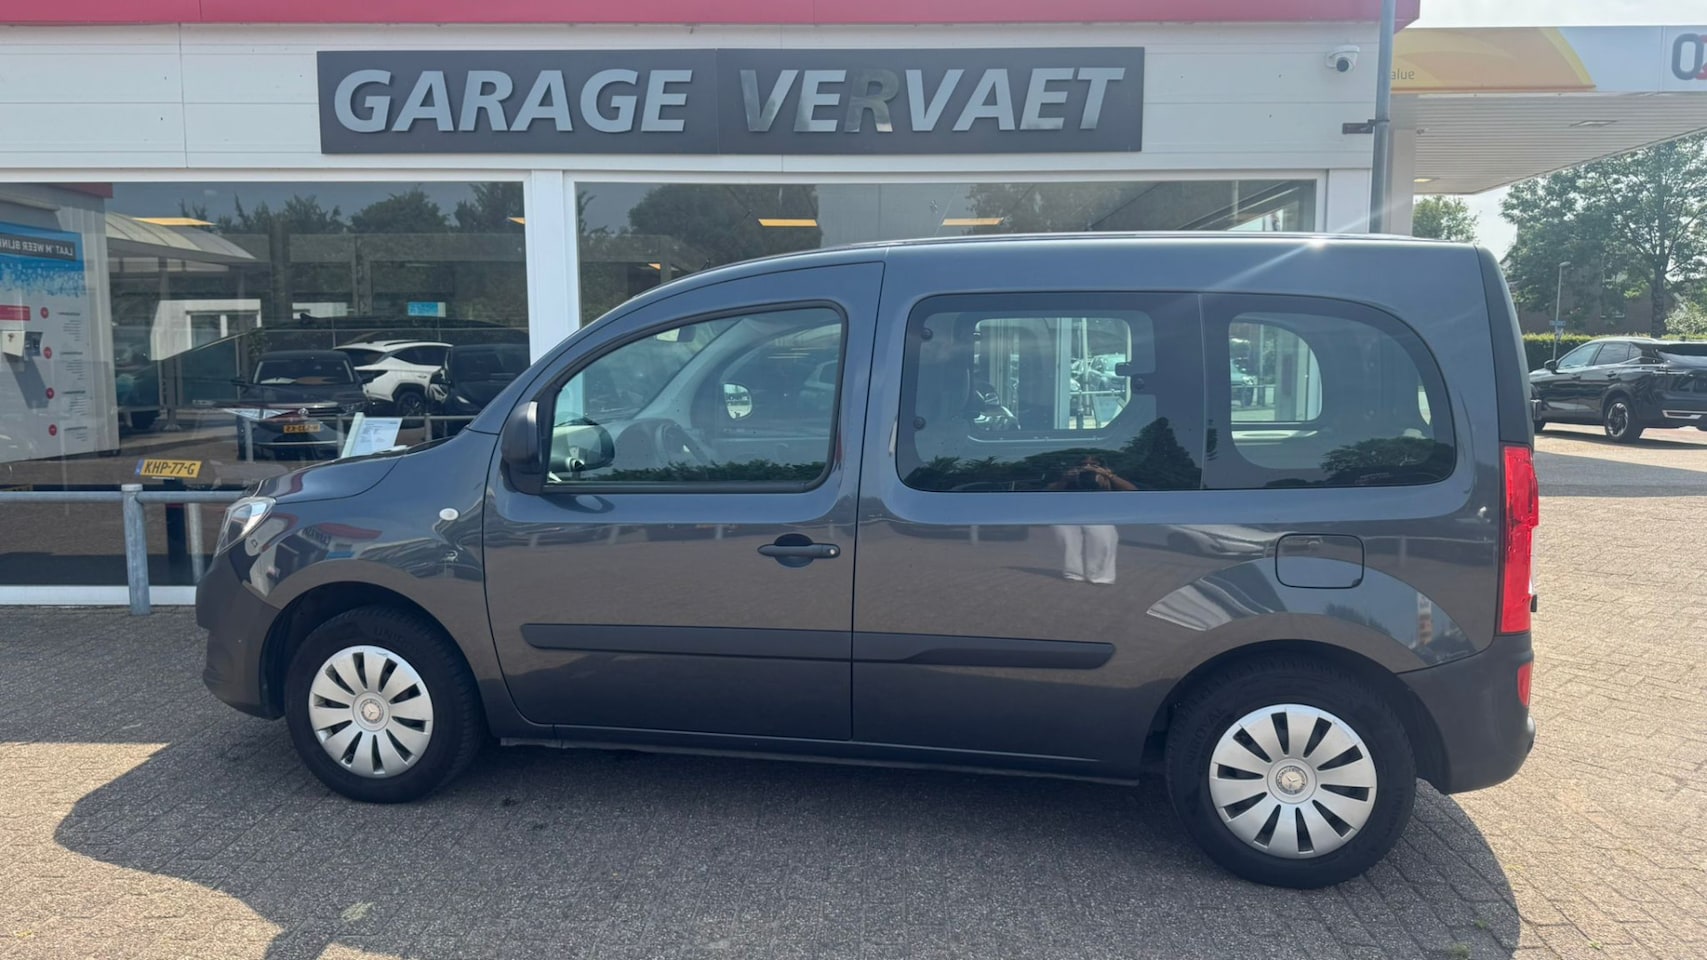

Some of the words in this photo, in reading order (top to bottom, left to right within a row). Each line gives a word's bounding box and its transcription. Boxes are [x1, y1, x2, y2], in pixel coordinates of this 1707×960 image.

[1391, 67, 1415, 80] alue
[334, 69, 693, 133] GARAGE
[739, 67, 1126, 132] VERVAET
[144, 460, 197, 475] KHP-77-G
